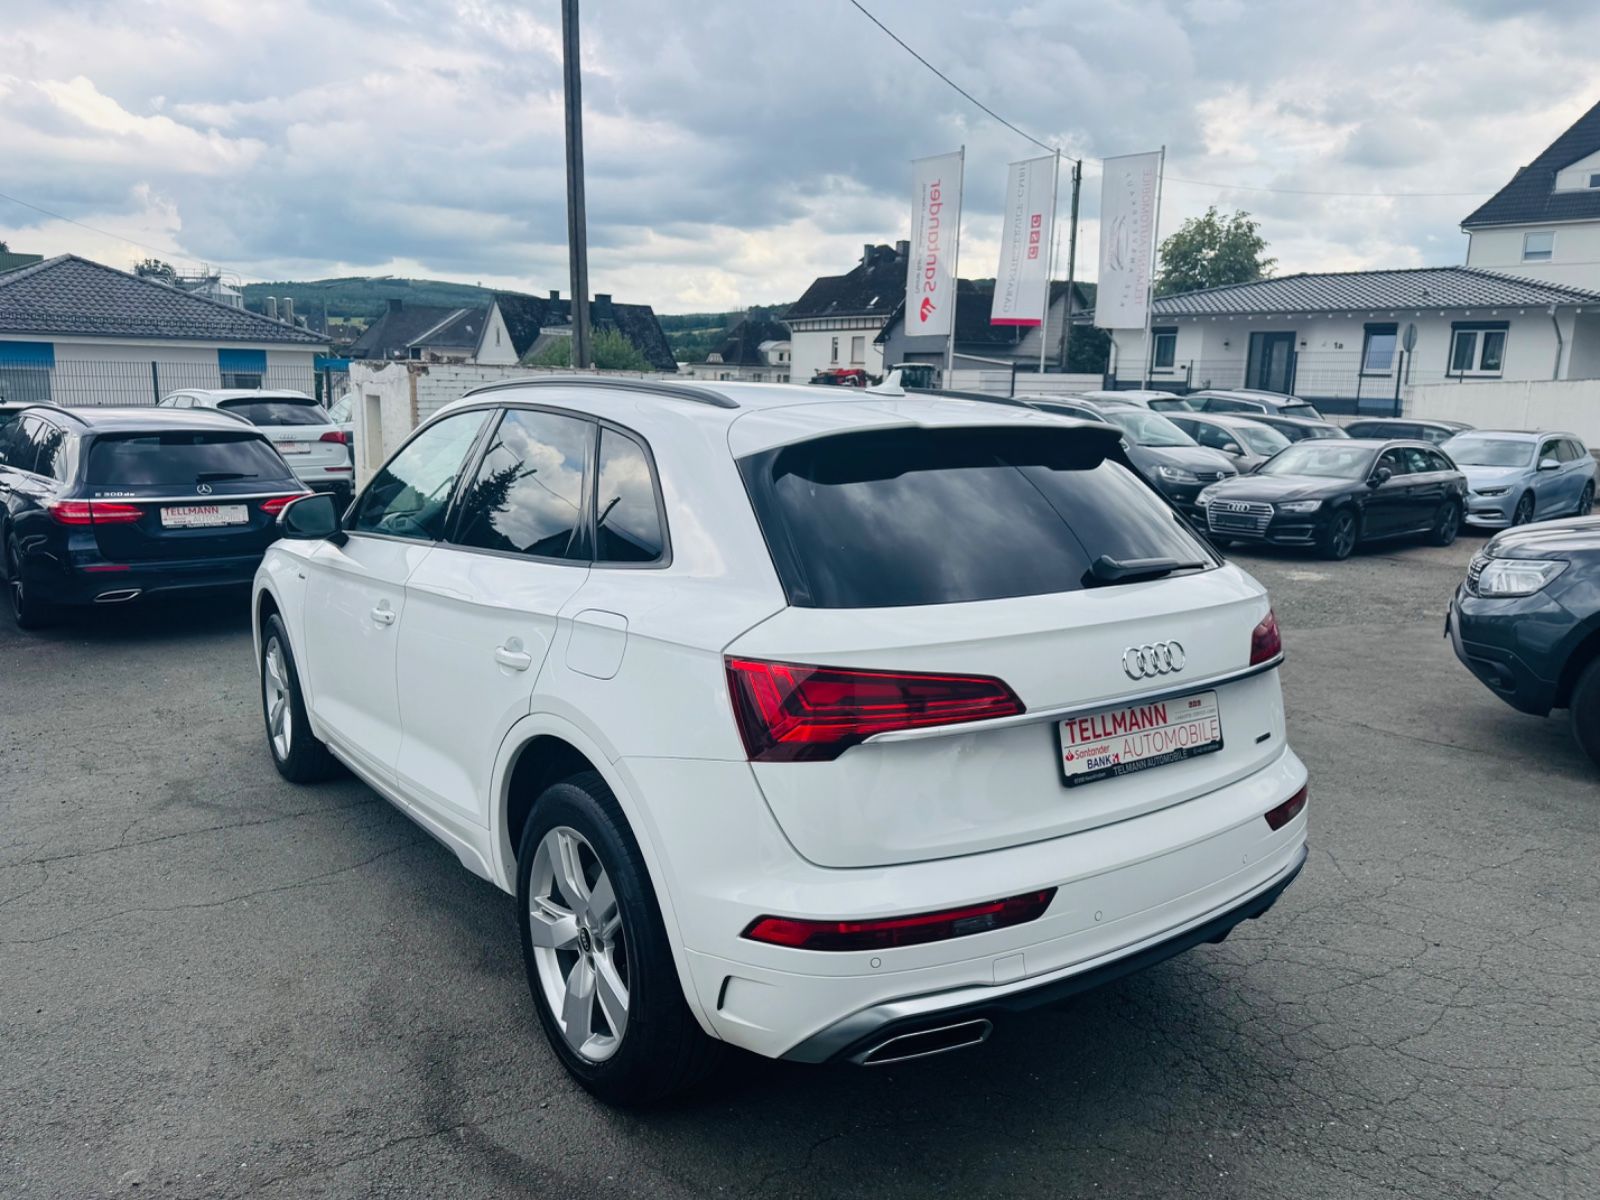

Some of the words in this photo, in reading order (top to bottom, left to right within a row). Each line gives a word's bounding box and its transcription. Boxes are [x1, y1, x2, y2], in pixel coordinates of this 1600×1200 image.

[165, 505, 219, 516] TELLMANN
[1065, 703, 1168, 744] TELLMANN
[1075, 744, 1110, 760] Santander
[1123, 719, 1219, 760] AUTOMOBILE
